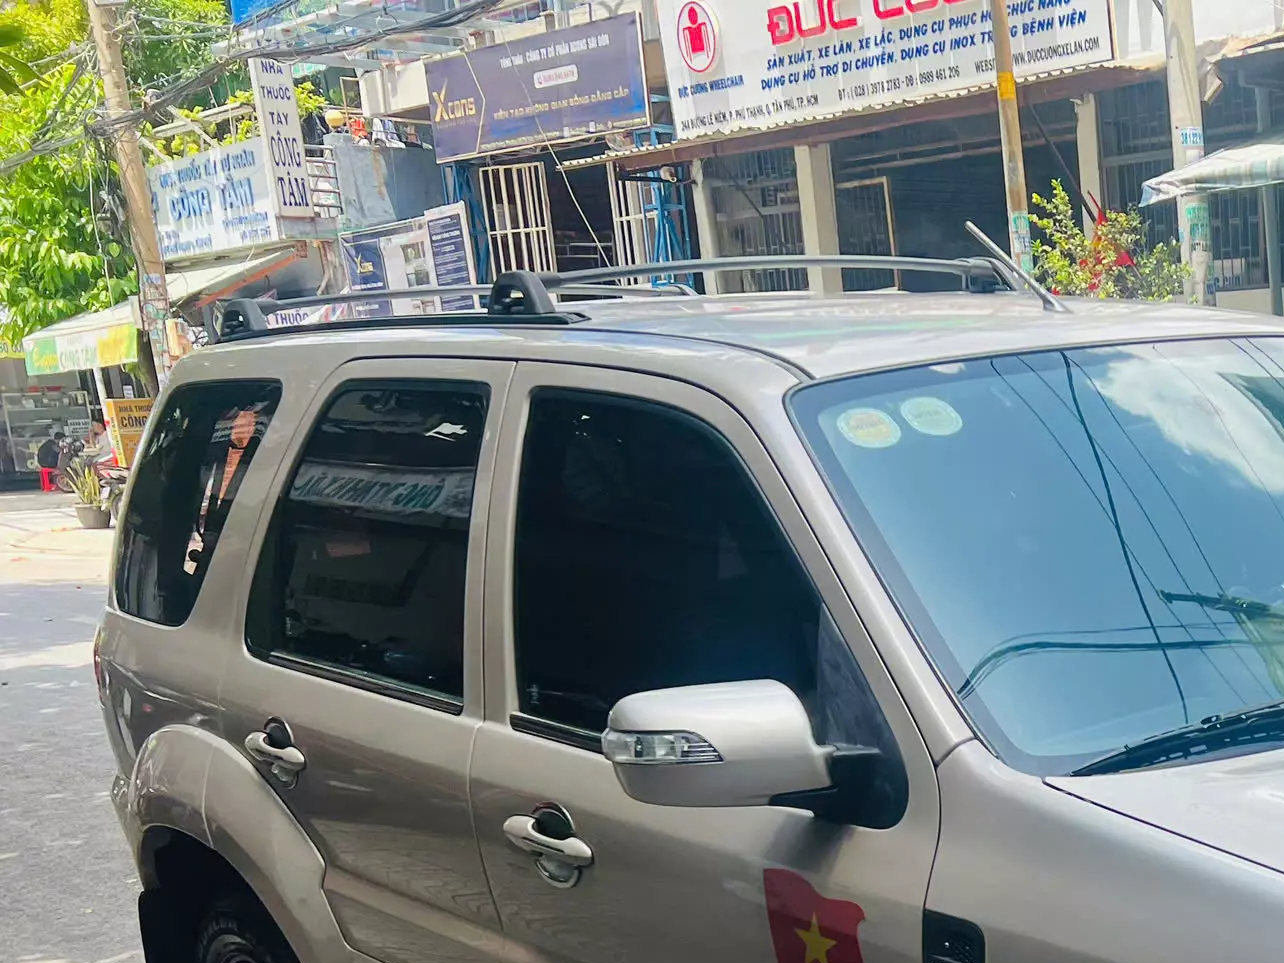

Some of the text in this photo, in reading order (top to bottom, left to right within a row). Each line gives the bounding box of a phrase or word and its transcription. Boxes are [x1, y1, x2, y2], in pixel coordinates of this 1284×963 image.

[818, 46, 830, 59] XE
[858, 36, 871, 51] XE
[842, 60, 852, 73] DI
[950, 34, 976, 51] INOX
[271, 131, 301, 168] CÔNG
[278, 172, 309, 207] TÂM
